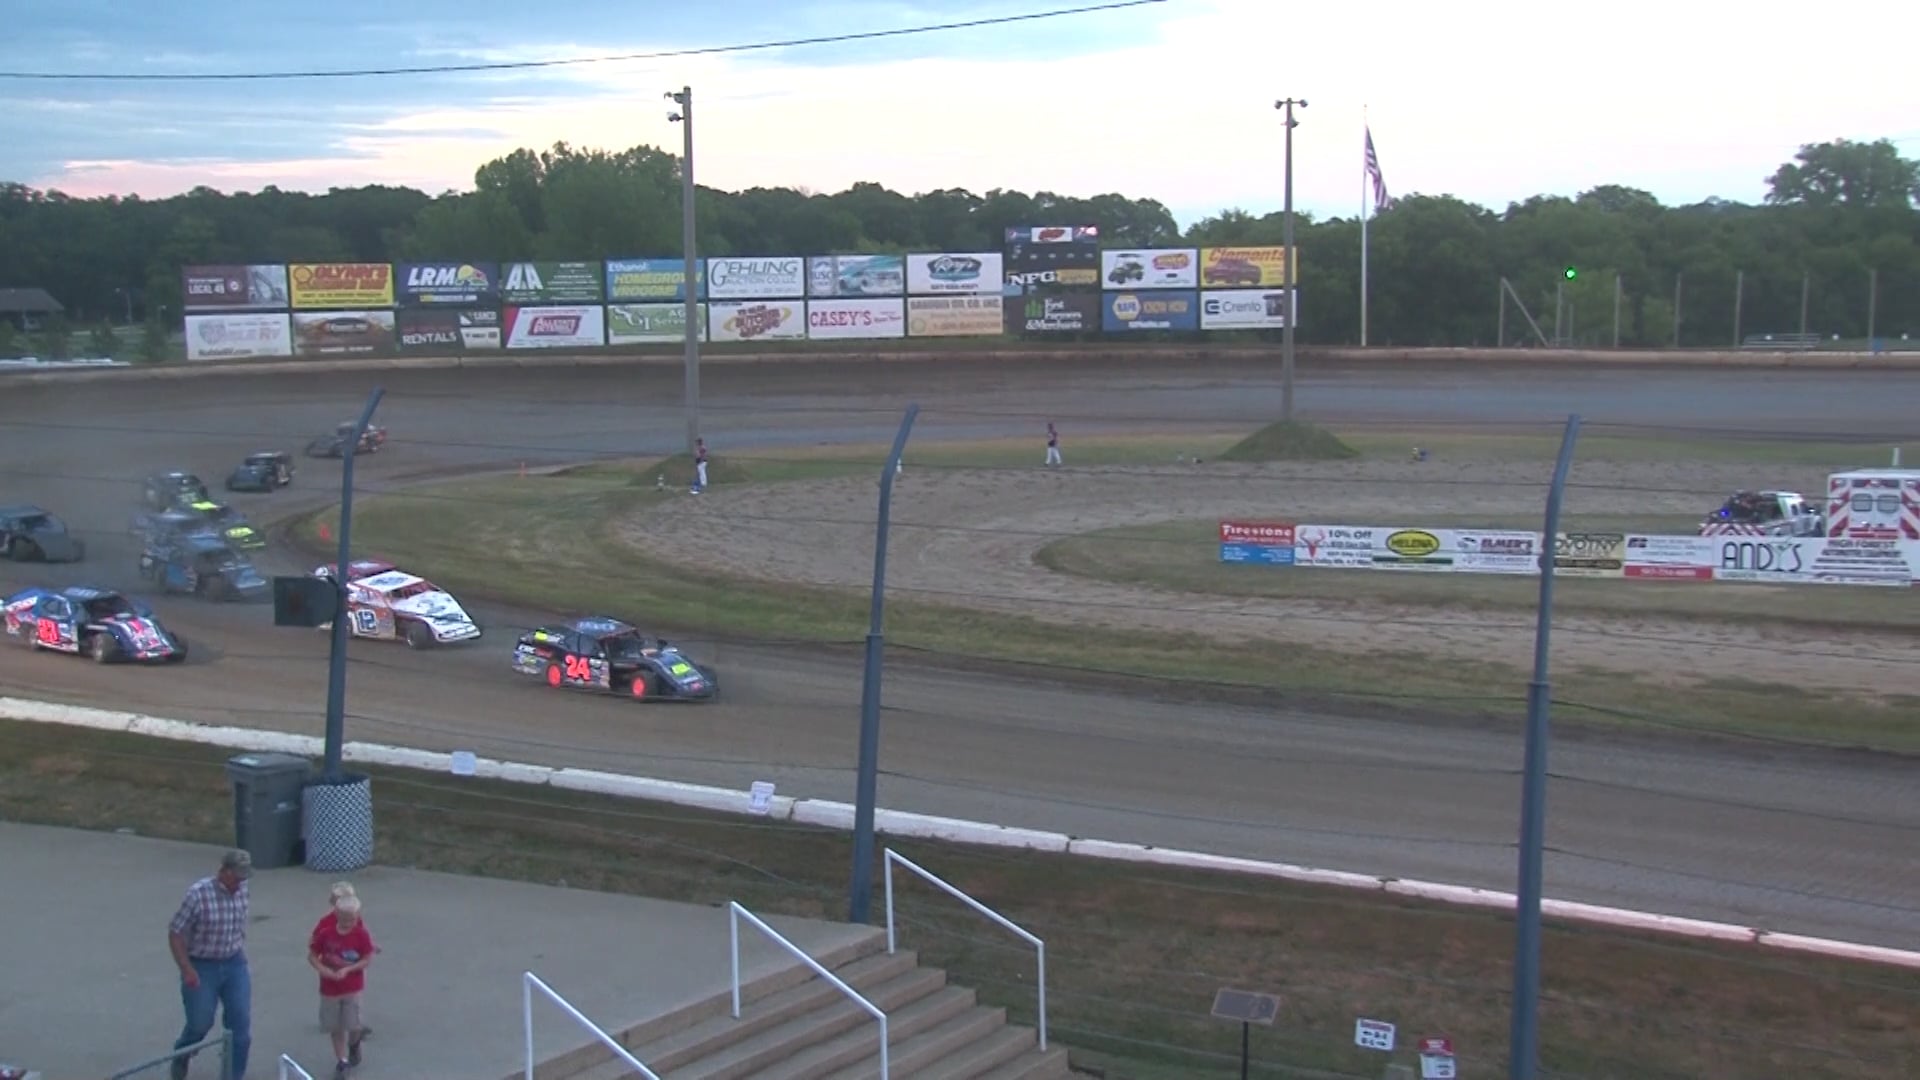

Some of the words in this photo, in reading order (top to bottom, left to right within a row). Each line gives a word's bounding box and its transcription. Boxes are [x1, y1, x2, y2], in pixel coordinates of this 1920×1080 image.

[407, 267, 457, 286] LRM
[711, 260, 800, 287] GEHLING
[1008, 271, 1055, 286] NPG
[810, 310, 872, 327] CASEY'S
[402, 332, 457, 345] RENTALS
[1222, 525, 1292, 537] Firestone
[1328, 530, 1351, 538] 10%
[564, 654, 591, 681] 24
